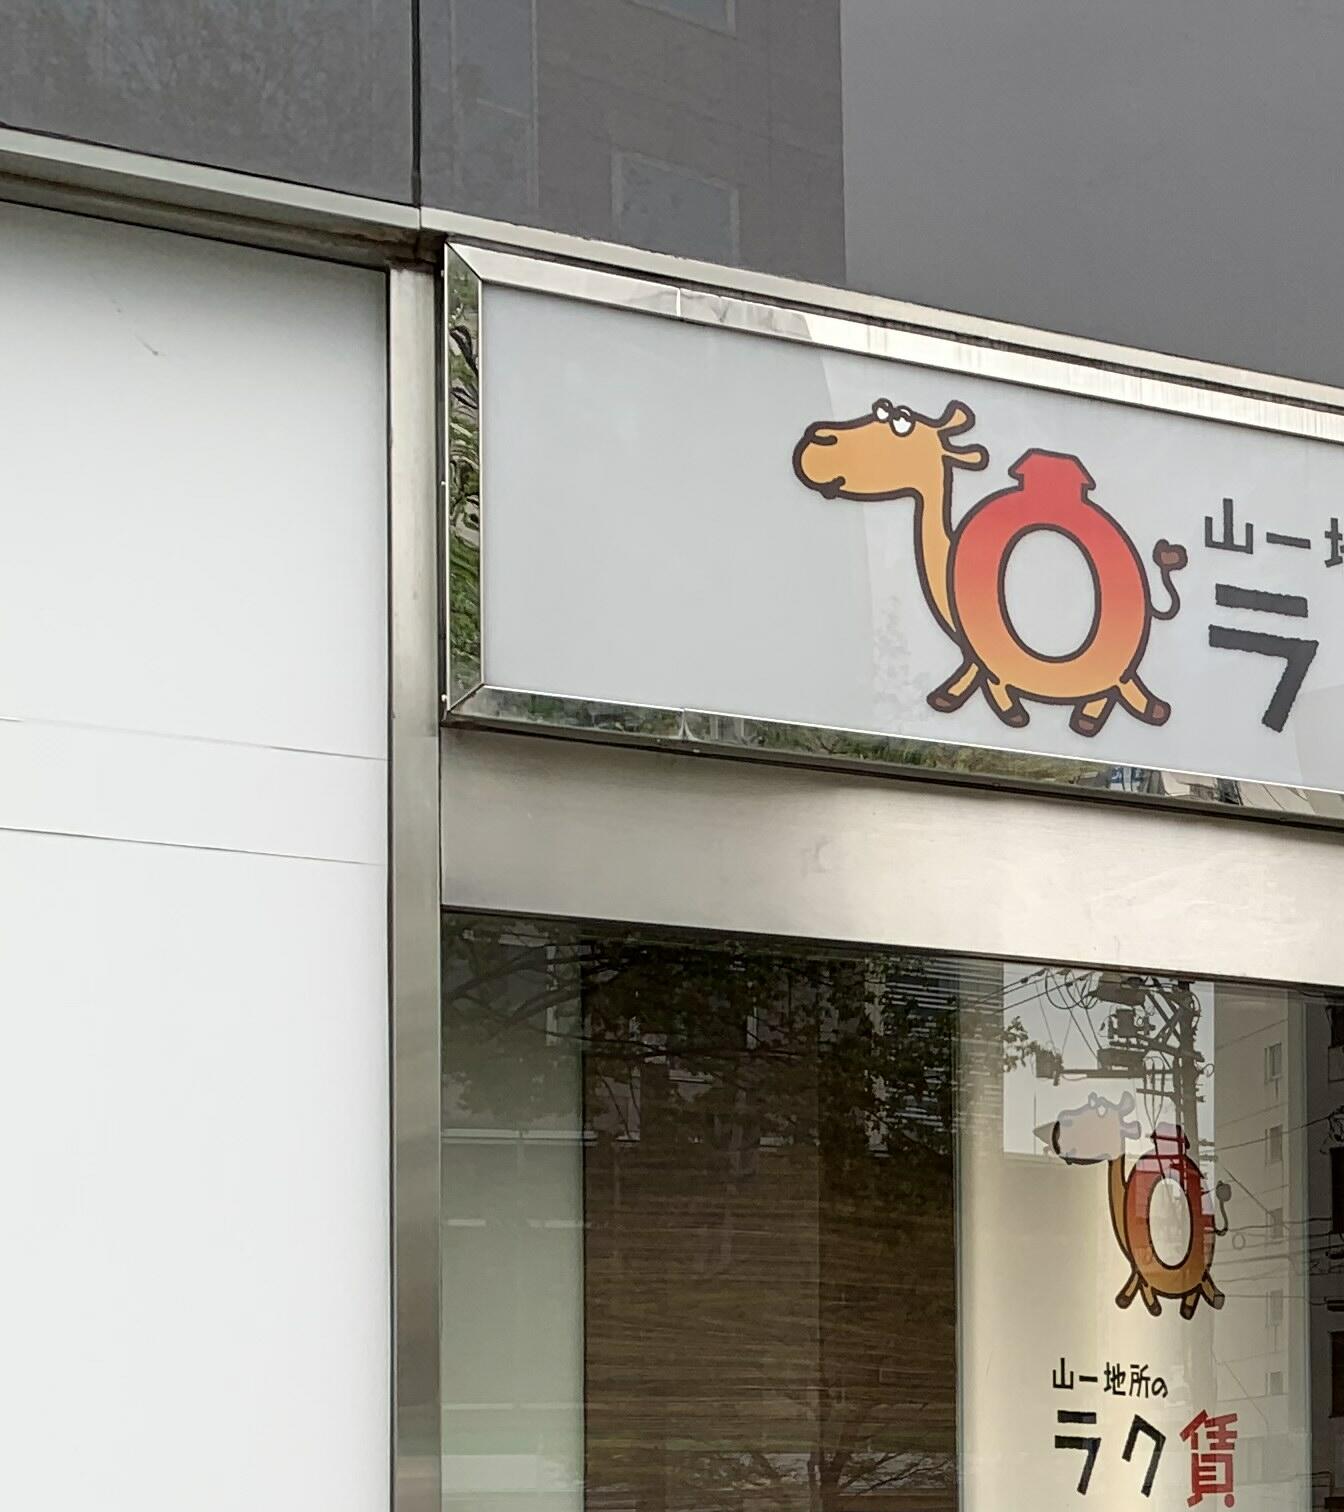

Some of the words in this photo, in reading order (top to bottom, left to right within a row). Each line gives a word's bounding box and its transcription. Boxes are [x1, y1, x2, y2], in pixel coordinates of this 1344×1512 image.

[1052, 1357, 1169, 1399] 山一地所の
[1054, 1409, 1239, 1508] ラク賃
